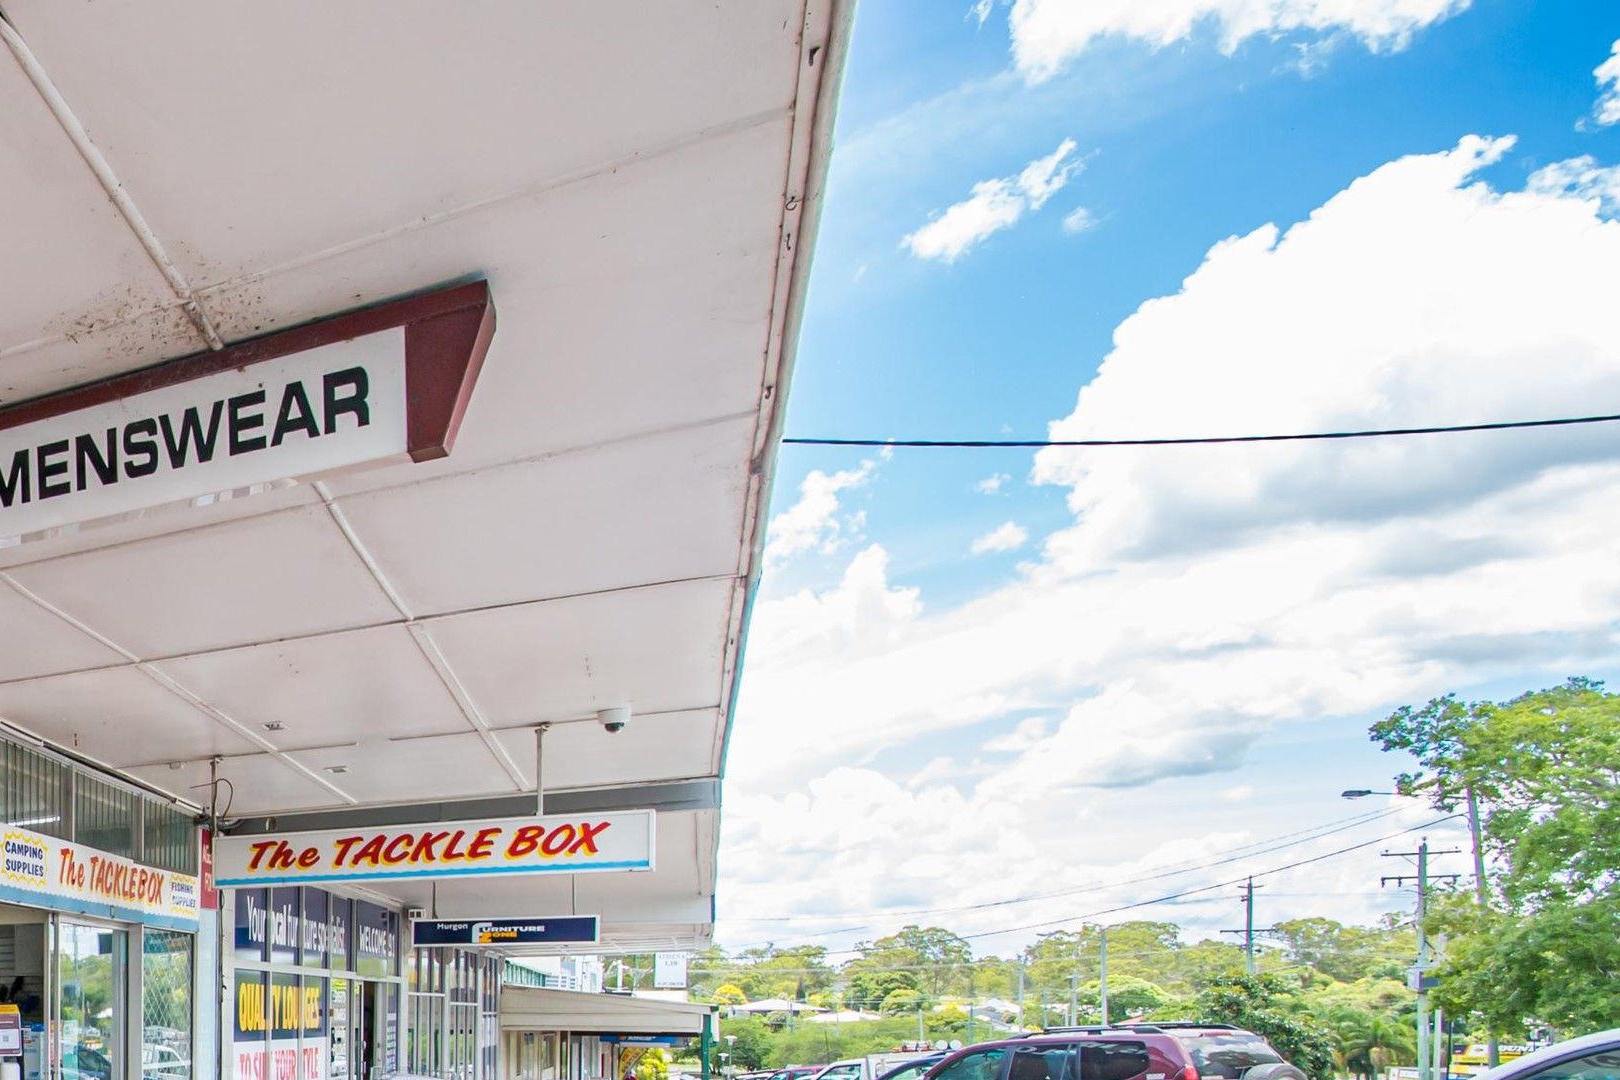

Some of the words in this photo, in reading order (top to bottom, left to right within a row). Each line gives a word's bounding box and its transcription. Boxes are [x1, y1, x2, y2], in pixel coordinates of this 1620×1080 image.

[4, 840, 43, 861] CAMPING
[249, 840, 321, 871] The
[333, 828, 502, 868] TACKLE
[506, 820, 612, 859] BOX
[5, 858, 44, 878] SUPPLIES
[59, 848, 86, 888] The
[172, 895, 196, 908] SUPPLIES
[247, 896, 266, 943] Your
[437, 923, 468, 932] Murgon
[472, 922, 545, 944] FURNITURE
[479, 931, 517, 944] ZONE
